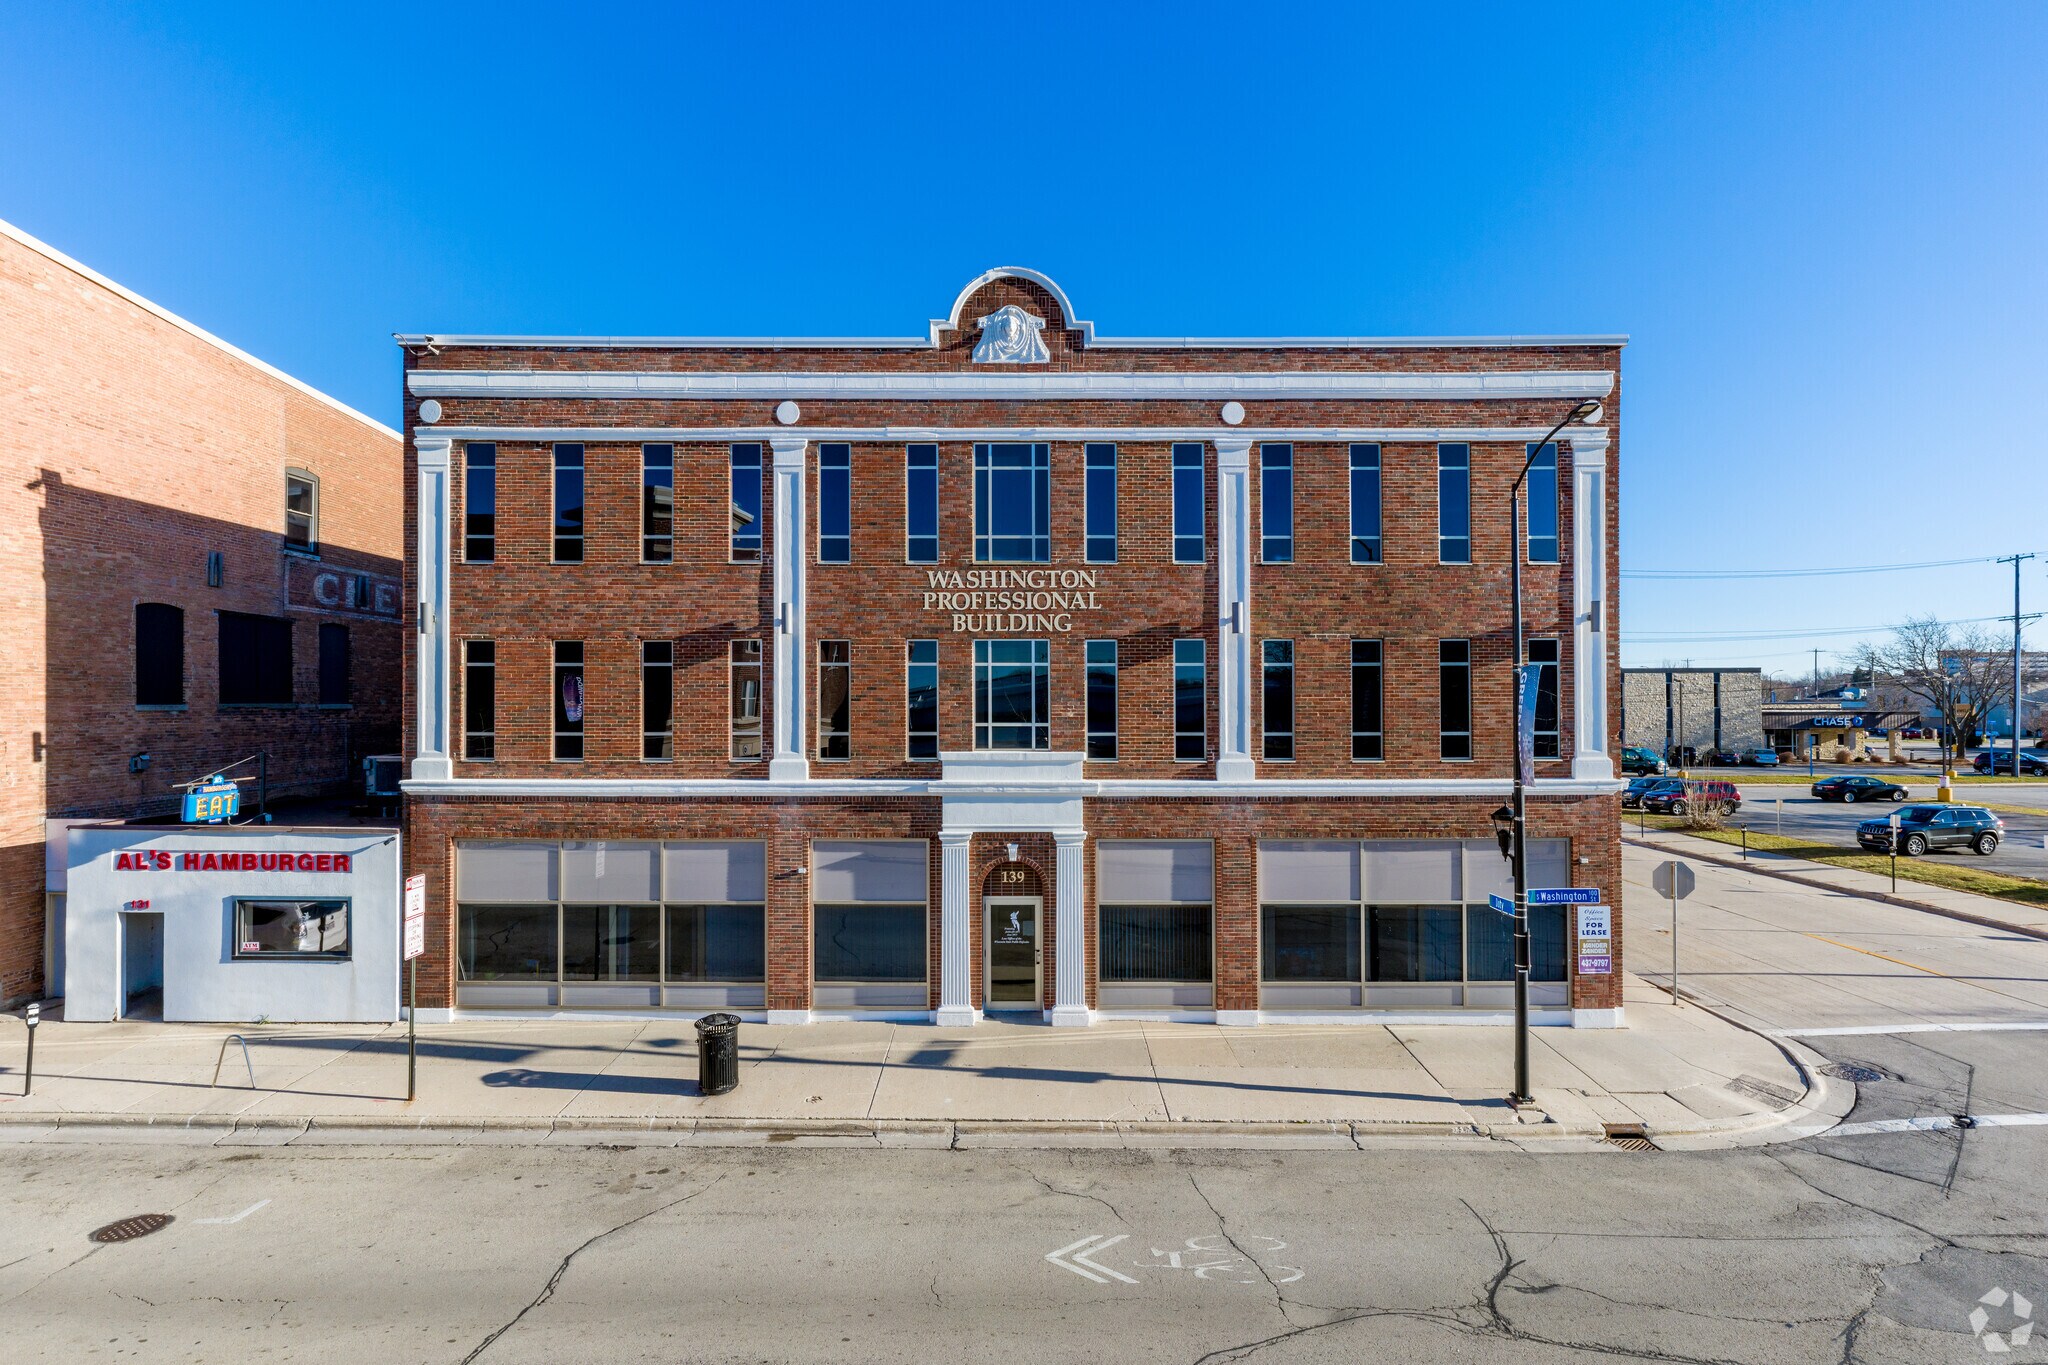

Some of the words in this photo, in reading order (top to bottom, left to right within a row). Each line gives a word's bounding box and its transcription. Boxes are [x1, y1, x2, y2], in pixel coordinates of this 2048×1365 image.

[927, 570, 1098, 588] WASHINGTON
[922, 592, 1101, 610] PROFESSIONAL
[952, 613, 1073, 632] BUILDING
[1814, 717, 1850, 726] CHASE
[195, 793, 236, 818] EAT
[116, 850, 172, 870] AL'S
[184, 853, 351, 872] HAMBURGER
[1001, 871, 1025, 883] 139
[131, 900, 150, 910] 131
[1540, 892, 1588, 903] Washington
